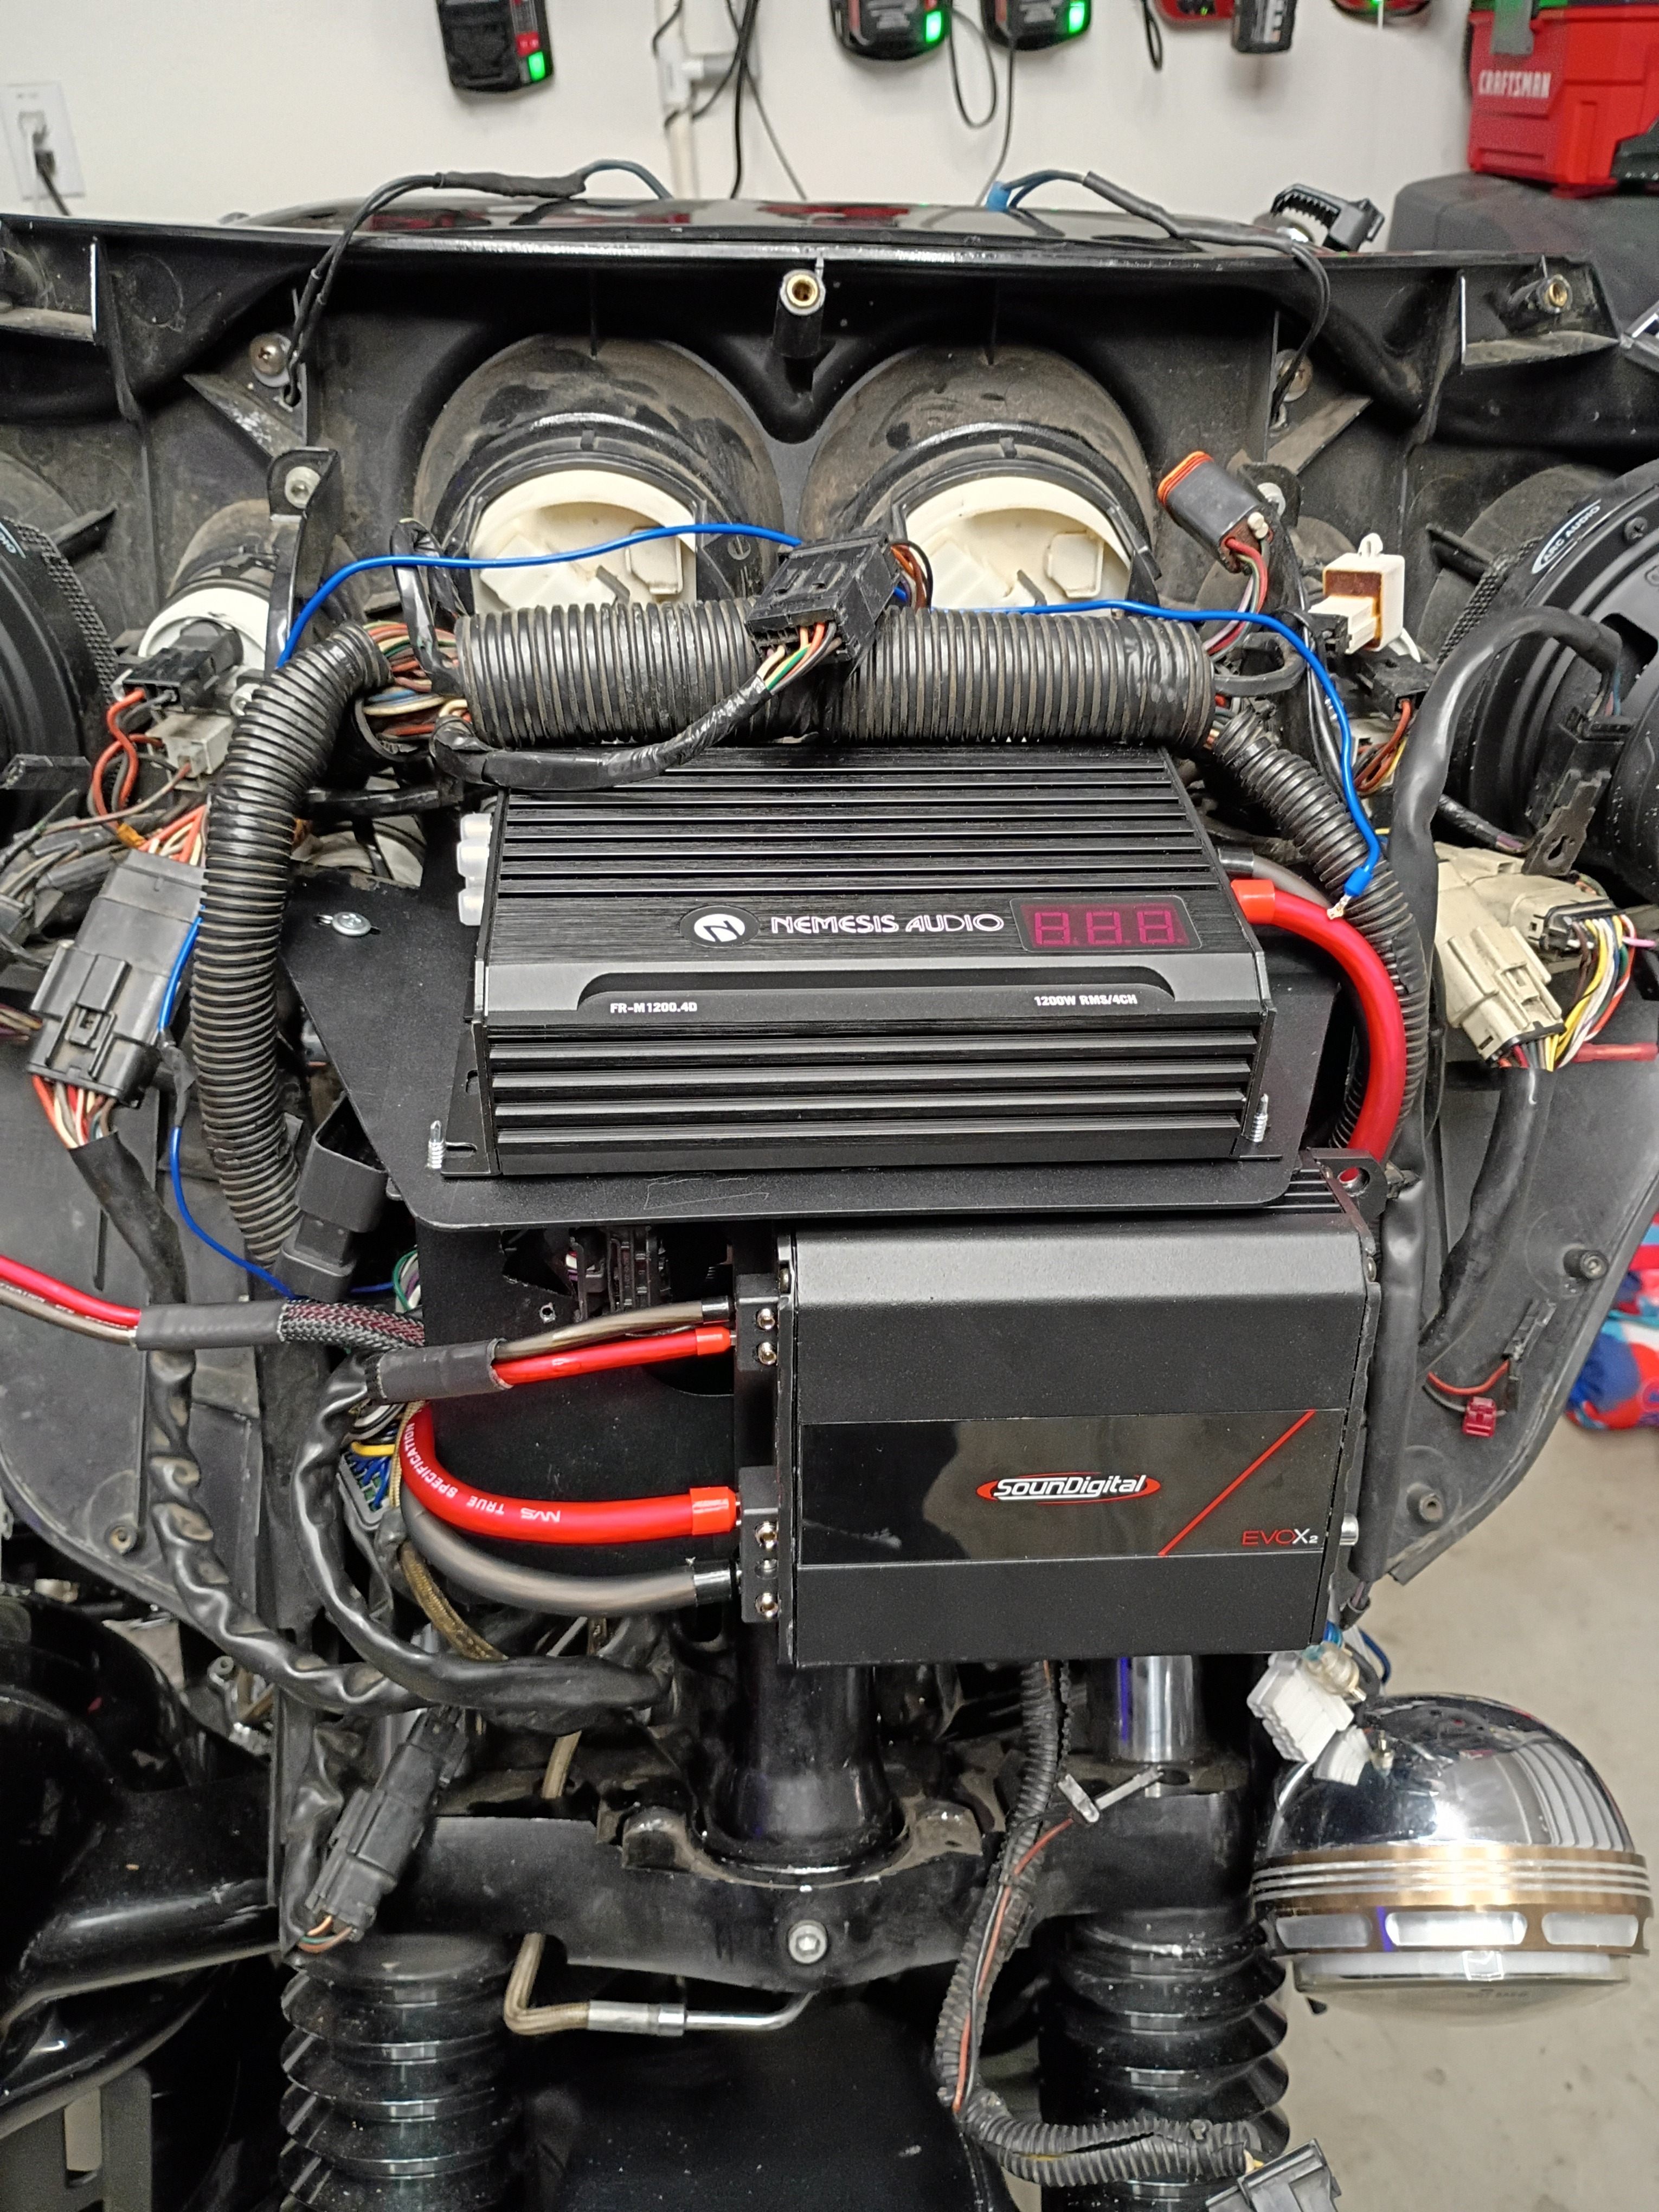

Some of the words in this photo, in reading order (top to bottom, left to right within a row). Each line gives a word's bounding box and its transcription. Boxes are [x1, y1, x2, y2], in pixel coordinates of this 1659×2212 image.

[1478, 70, 1552, 98] CRAFTSMAN
[1544, 538, 1565, 562] ARC
[1565, 505, 1600, 538] AUDIO
[771, 914, 899, 934] NEMESIS
[905, 913, 1005, 933] AUDIO
[610, 1001, 698, 1013] FR-M1200.4D
[1034, 995, 1076, 1006] 1200W
[1079, 994, 1138, 1005] RMS/4CH
[404, 1422, 459, 1499] SPECIFICATION
[993, 1474, 1147, 1500] SounDigital
[466, 1495, 505, 1515] TRUE
